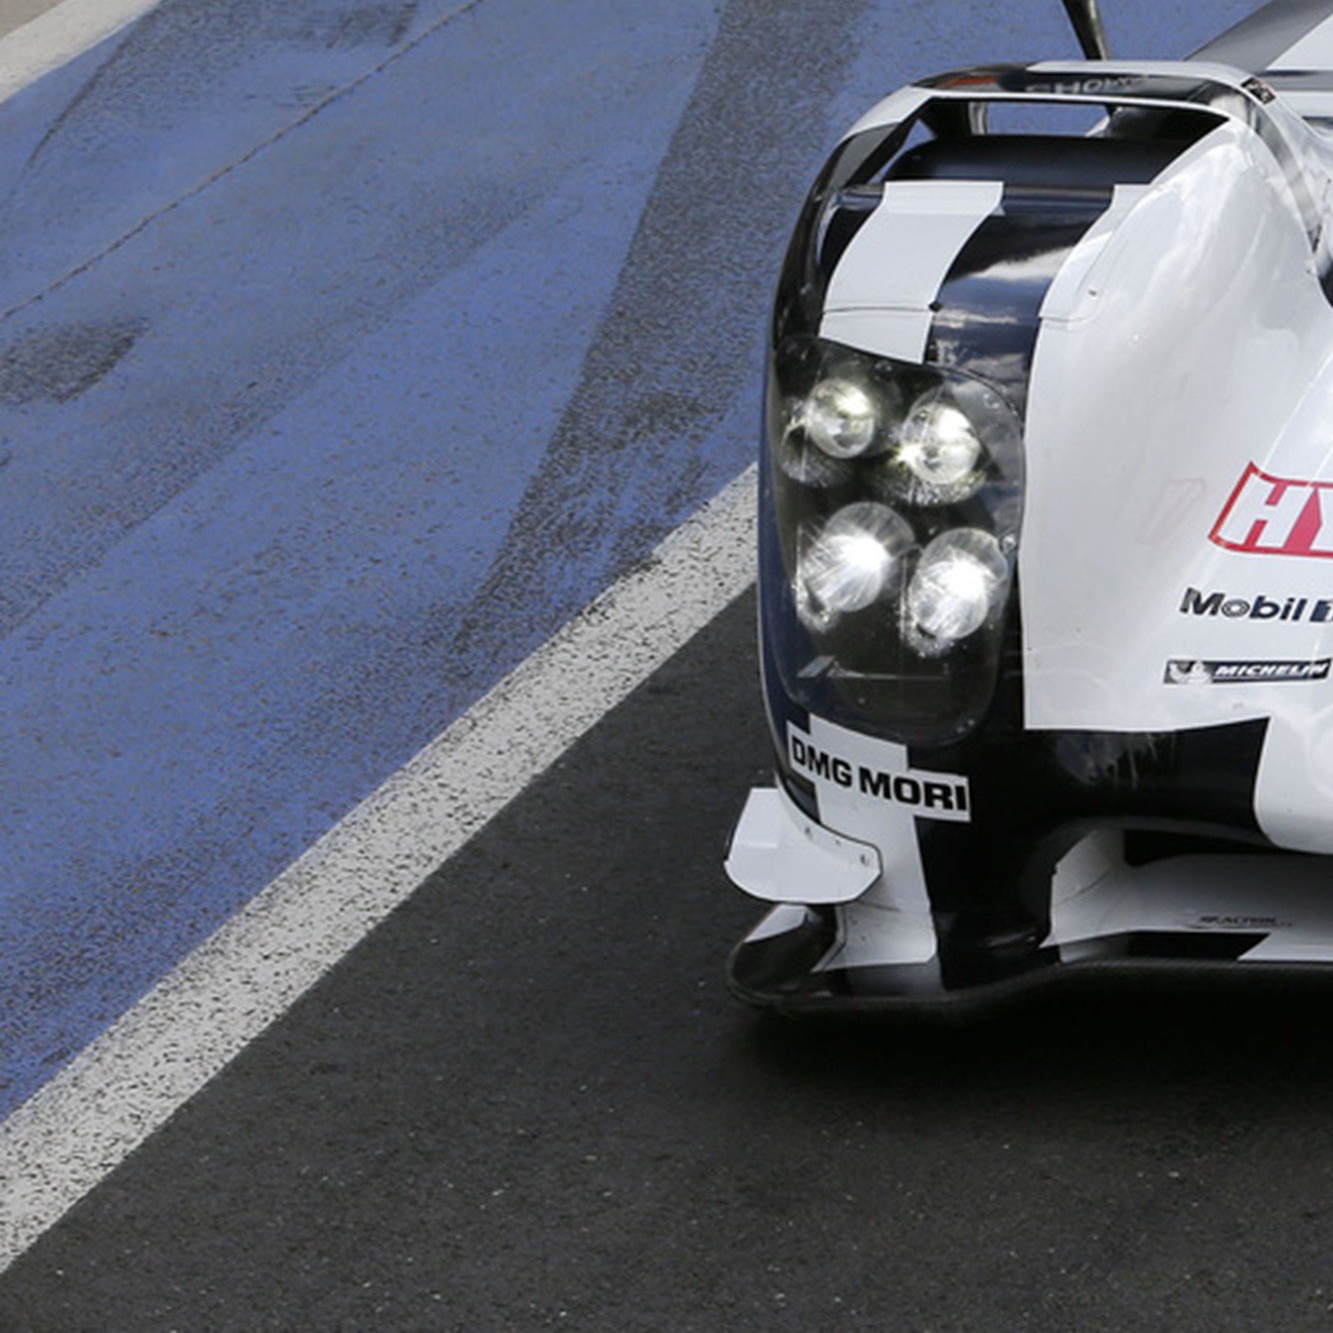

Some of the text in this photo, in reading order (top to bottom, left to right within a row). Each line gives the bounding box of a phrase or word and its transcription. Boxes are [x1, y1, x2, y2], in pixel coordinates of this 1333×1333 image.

[1179, 587, 1308, 622] Mobil
[1215, 662, 1328, 678] MICHELIN
[792, 735, 968, 811] DMG MORI
